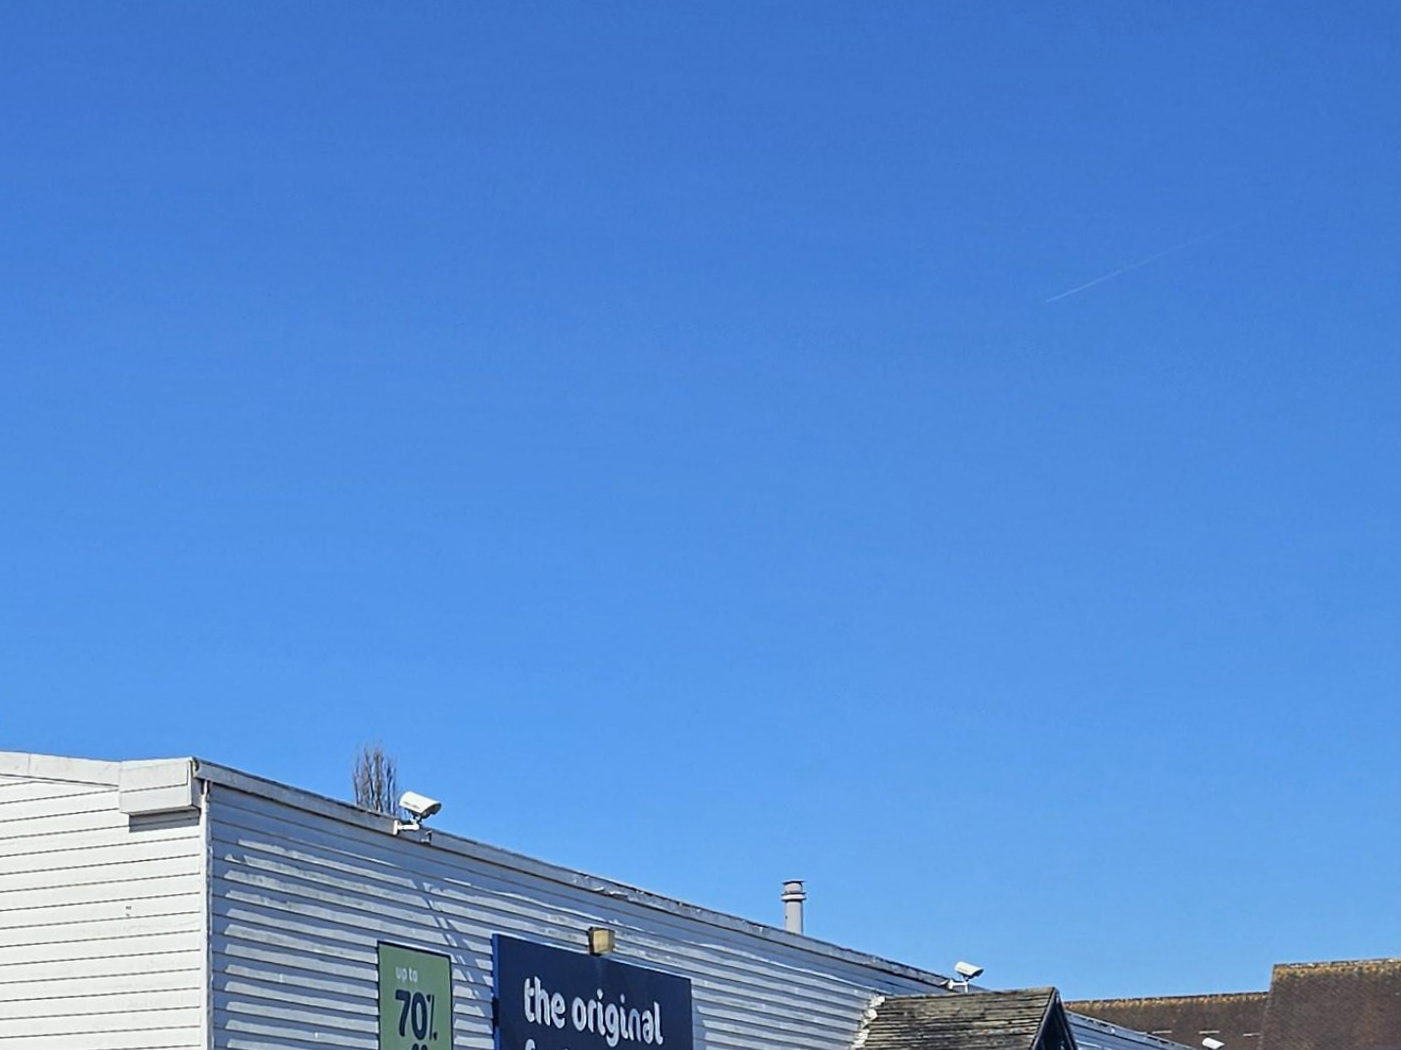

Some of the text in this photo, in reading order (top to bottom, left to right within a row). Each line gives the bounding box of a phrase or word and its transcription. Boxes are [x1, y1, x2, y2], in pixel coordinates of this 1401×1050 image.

[395, 966, 419, 982] up to
[395, 989, 438, 1042] 70%
[523, 976, 663, 1048] the original
